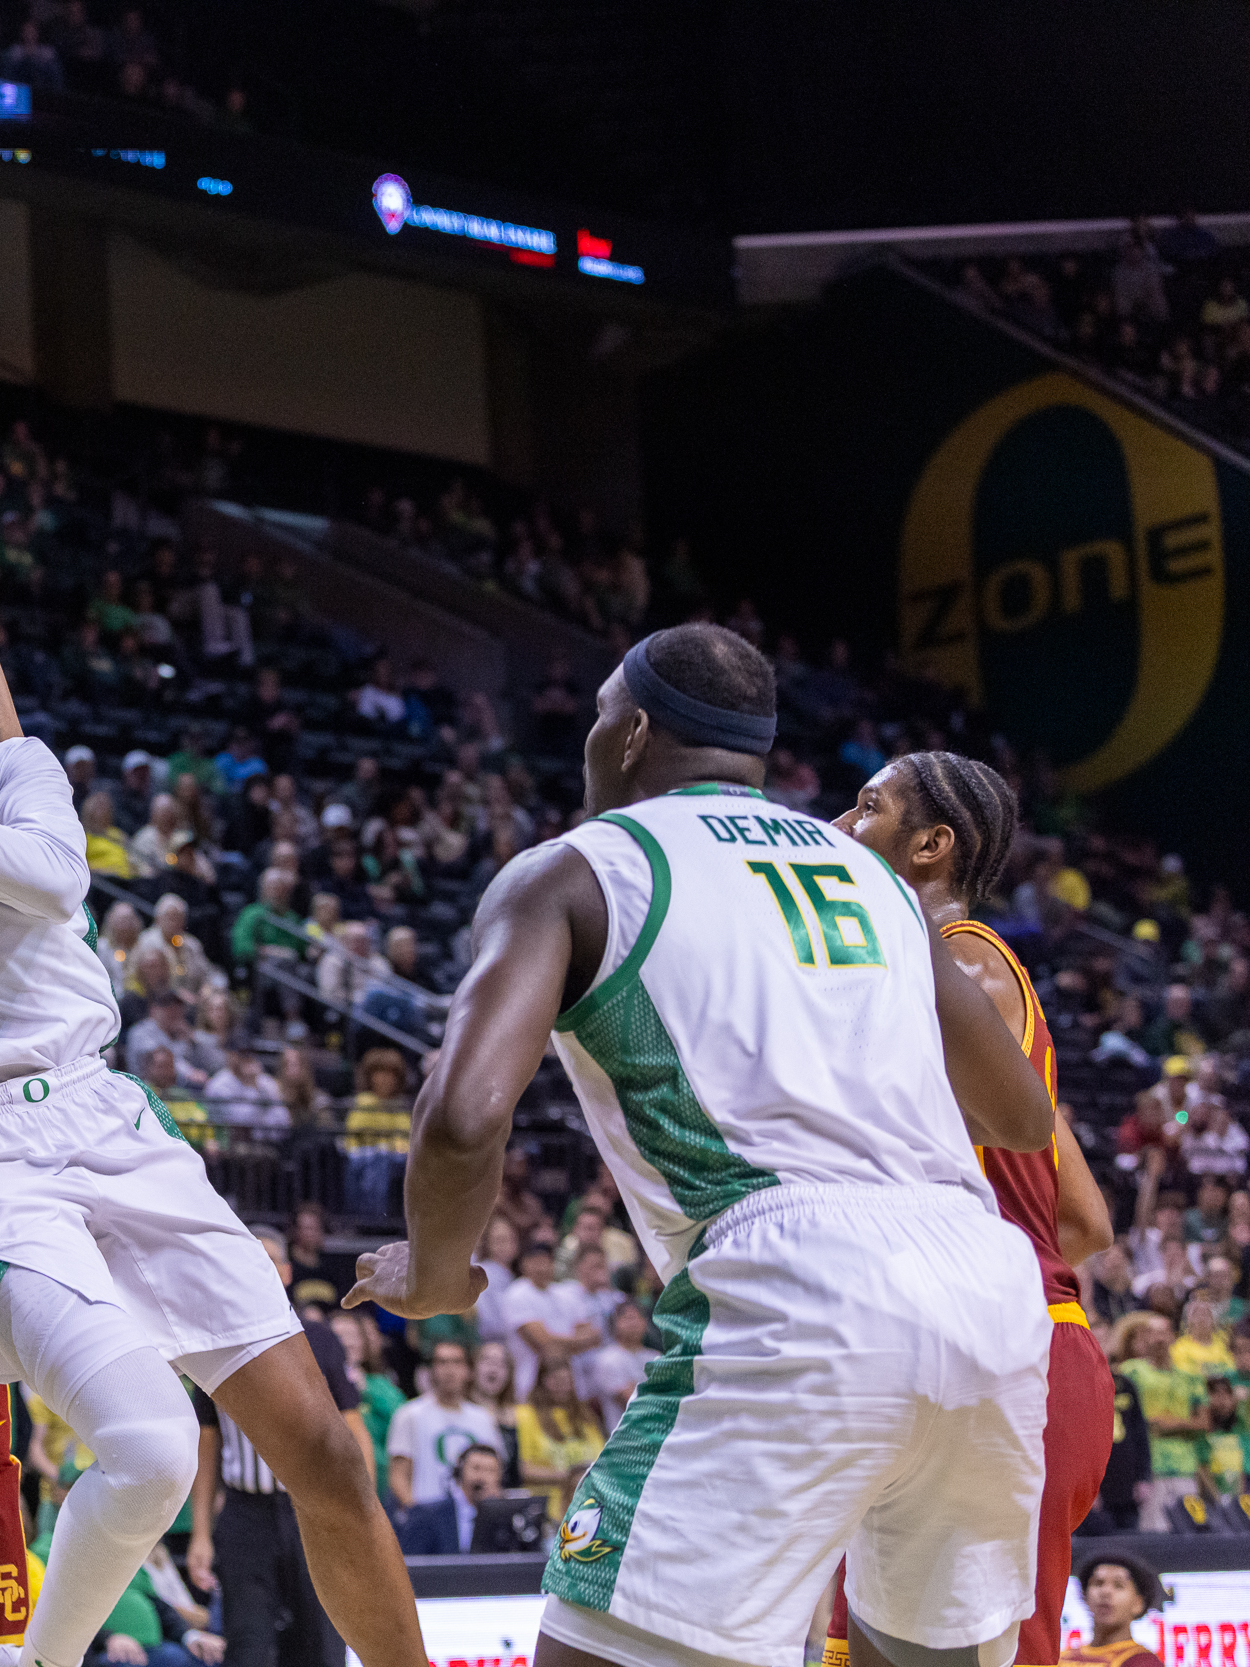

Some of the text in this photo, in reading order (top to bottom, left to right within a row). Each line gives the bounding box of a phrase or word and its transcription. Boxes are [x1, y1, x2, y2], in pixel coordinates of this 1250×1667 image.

[696, 814, 836, 848] DEMIR
[744, 859, 888, 970] 16
[23, 1077, 50, 1103] O
